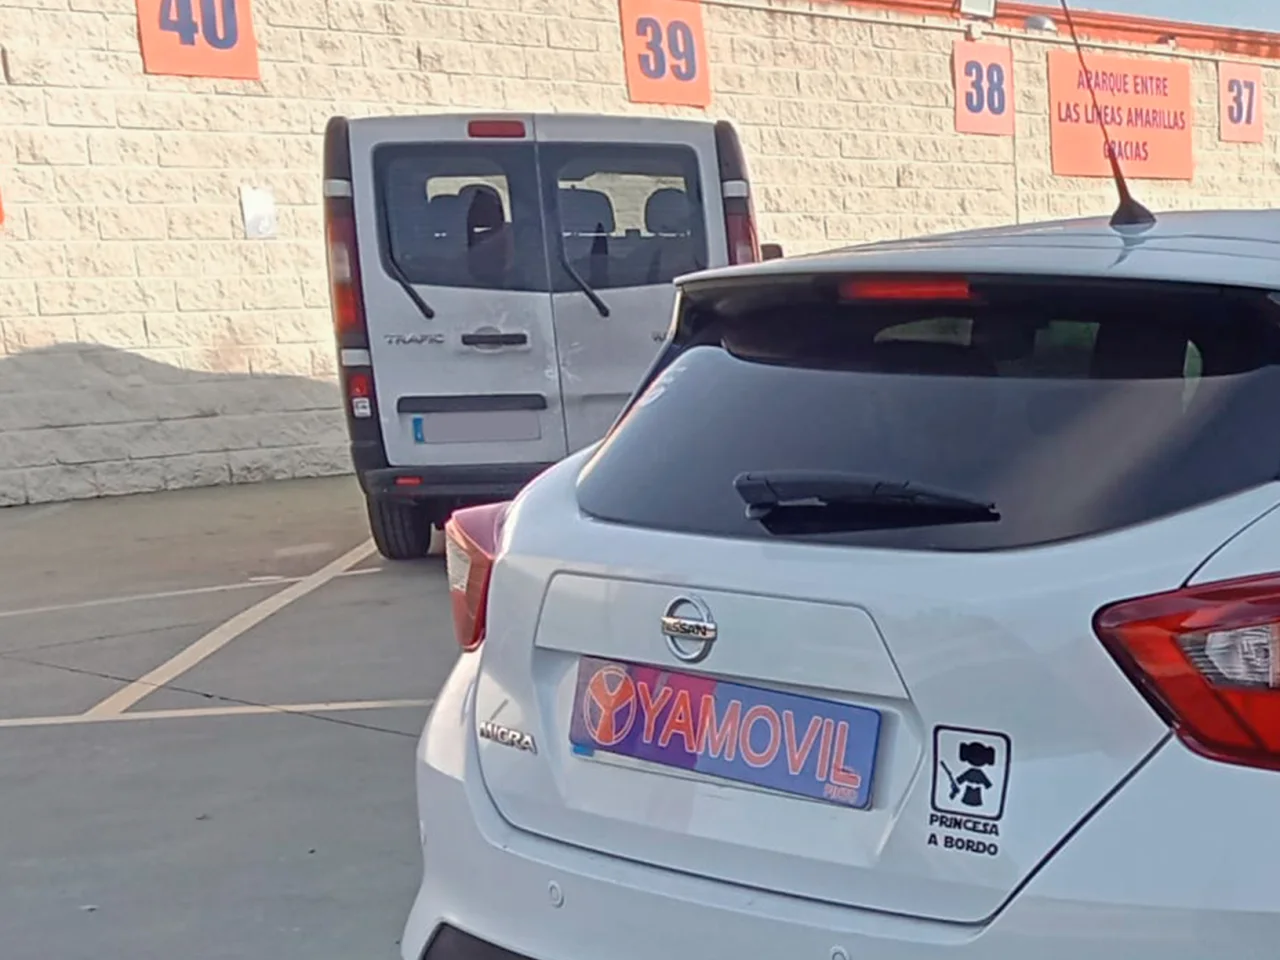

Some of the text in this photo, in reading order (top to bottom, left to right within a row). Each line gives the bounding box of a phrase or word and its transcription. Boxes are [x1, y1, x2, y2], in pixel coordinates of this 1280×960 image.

[159, 0, 239, 49] 40
[636, 17, 697, 82] 39
[964, 60, 1005, 115] 38
[1077, 70, 1168, 97] APARQUE ENTRE
[1057, 101, 1080, 123] LAS
[1126, 107, 1186, 130] AMARILLAS
[1227, 79, 1255, 125] 37
[1103, 140, 1148, 161] GRACIAS
[384, 333, 445, 345] TRAFIC
[662, 622, 707, 636] NISSAN
[479, 720, 537, 755] MICRA
[637, 681, 862, 790] YAMOVIL
[928, 813, 1000, 837] PRINCESA
[927, 833, 999, 856] A BORDO
